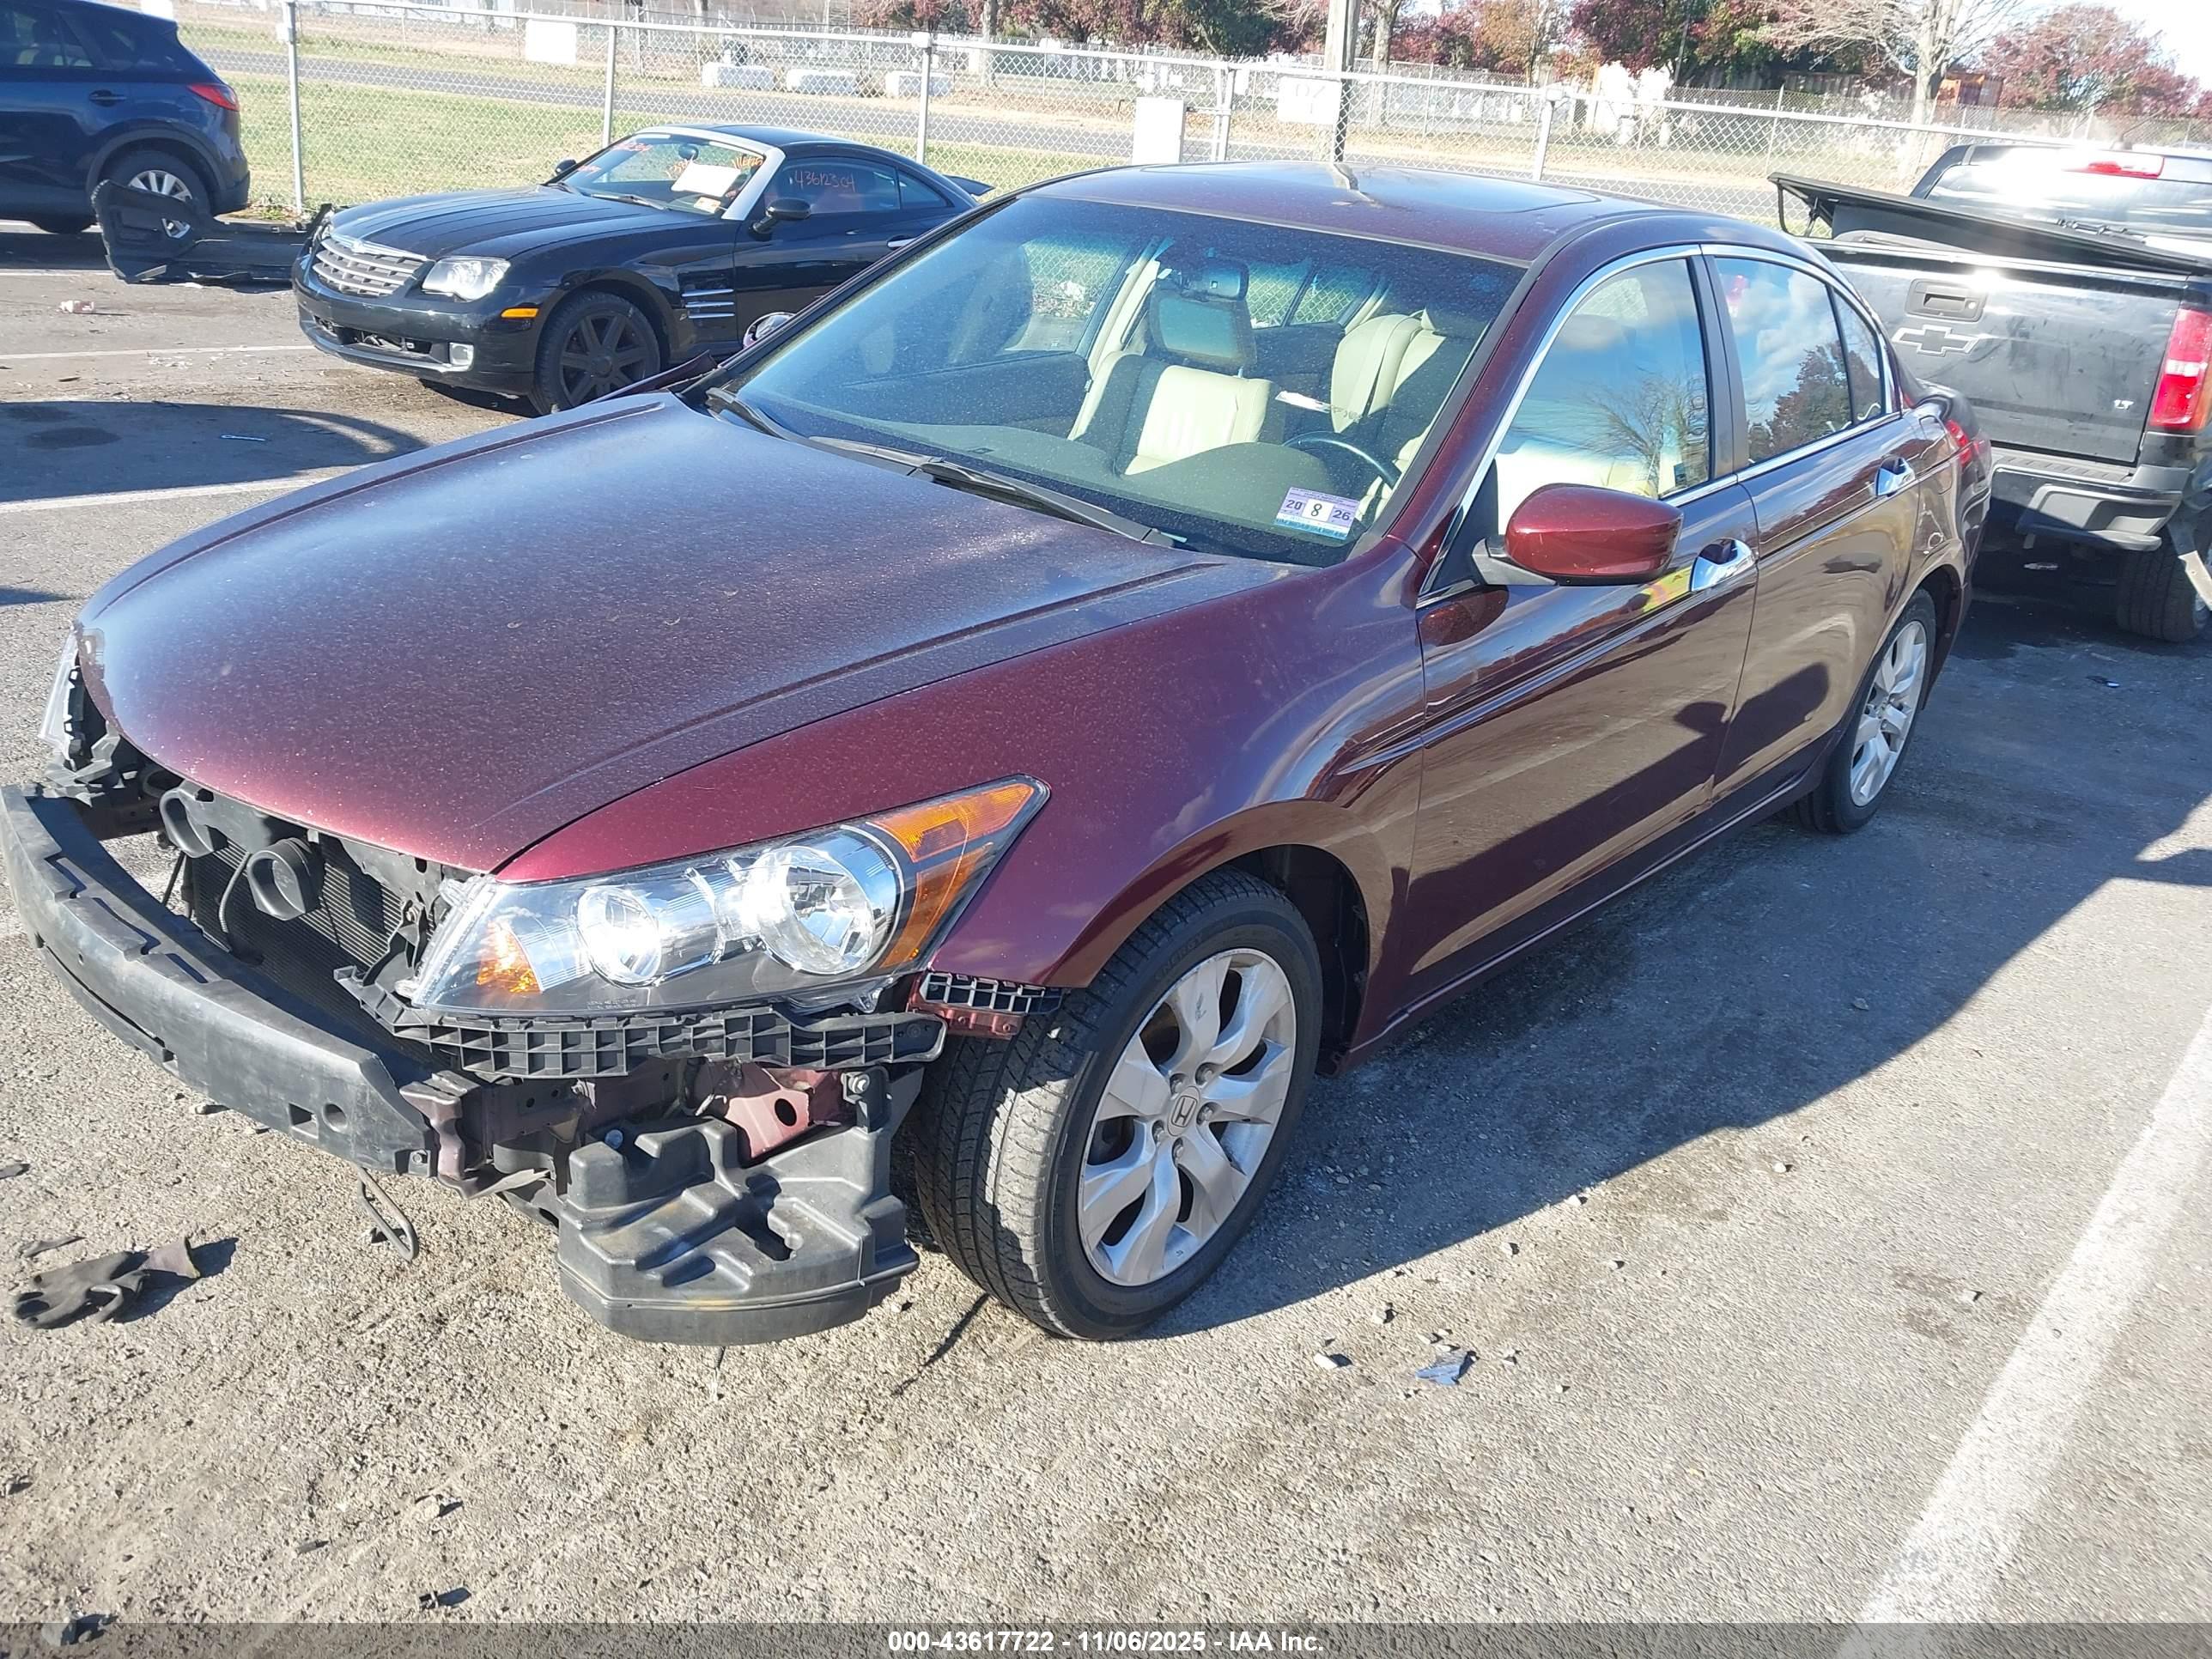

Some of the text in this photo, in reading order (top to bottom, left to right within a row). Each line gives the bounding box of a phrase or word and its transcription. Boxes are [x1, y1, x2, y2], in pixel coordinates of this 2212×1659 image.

[2113, 399, 2134, 410] LT
[1285, 500, 1352, 520] 20 8 26
